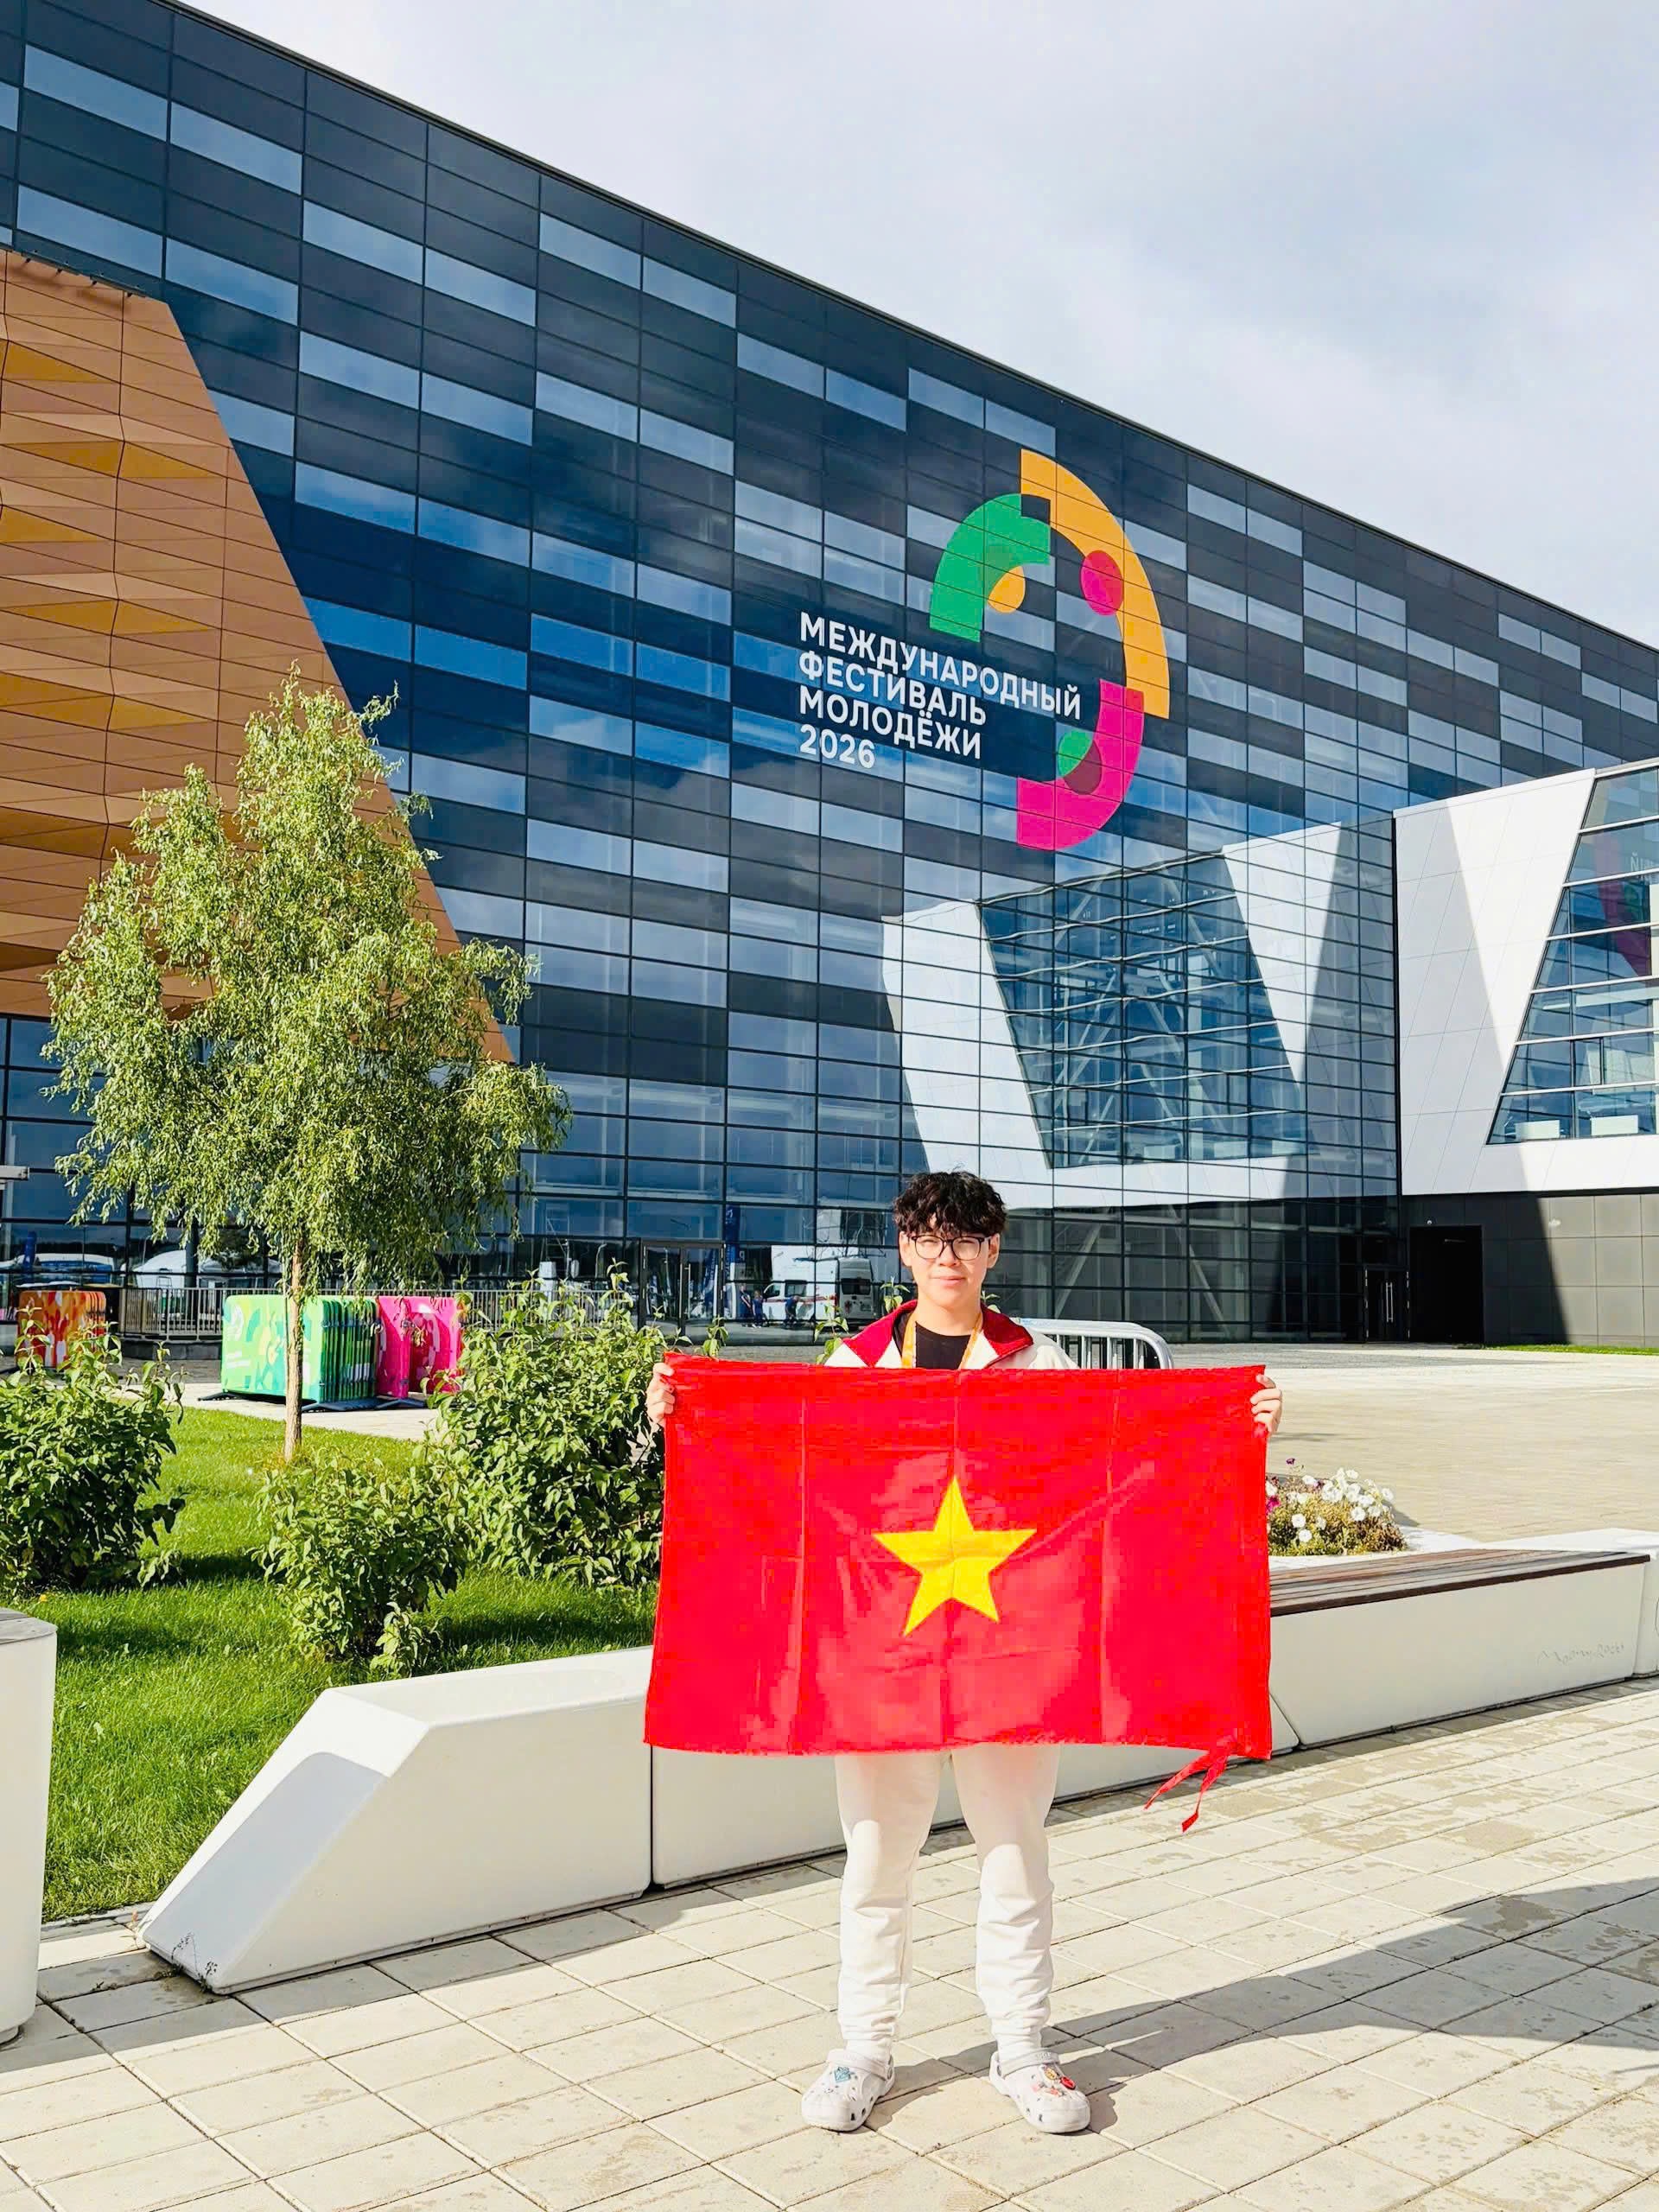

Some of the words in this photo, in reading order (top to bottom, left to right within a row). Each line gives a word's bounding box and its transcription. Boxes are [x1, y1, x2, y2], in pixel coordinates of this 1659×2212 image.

[799, 650, 987, 726] ФЕСТИВАЛЬ
[800, 612, 1081, 721] МЕЖДУНАРОДНЫЙ
[799, 685, 982, 760] МОЛОДЁЖИ
[799, 724, 876, 770] 2026
